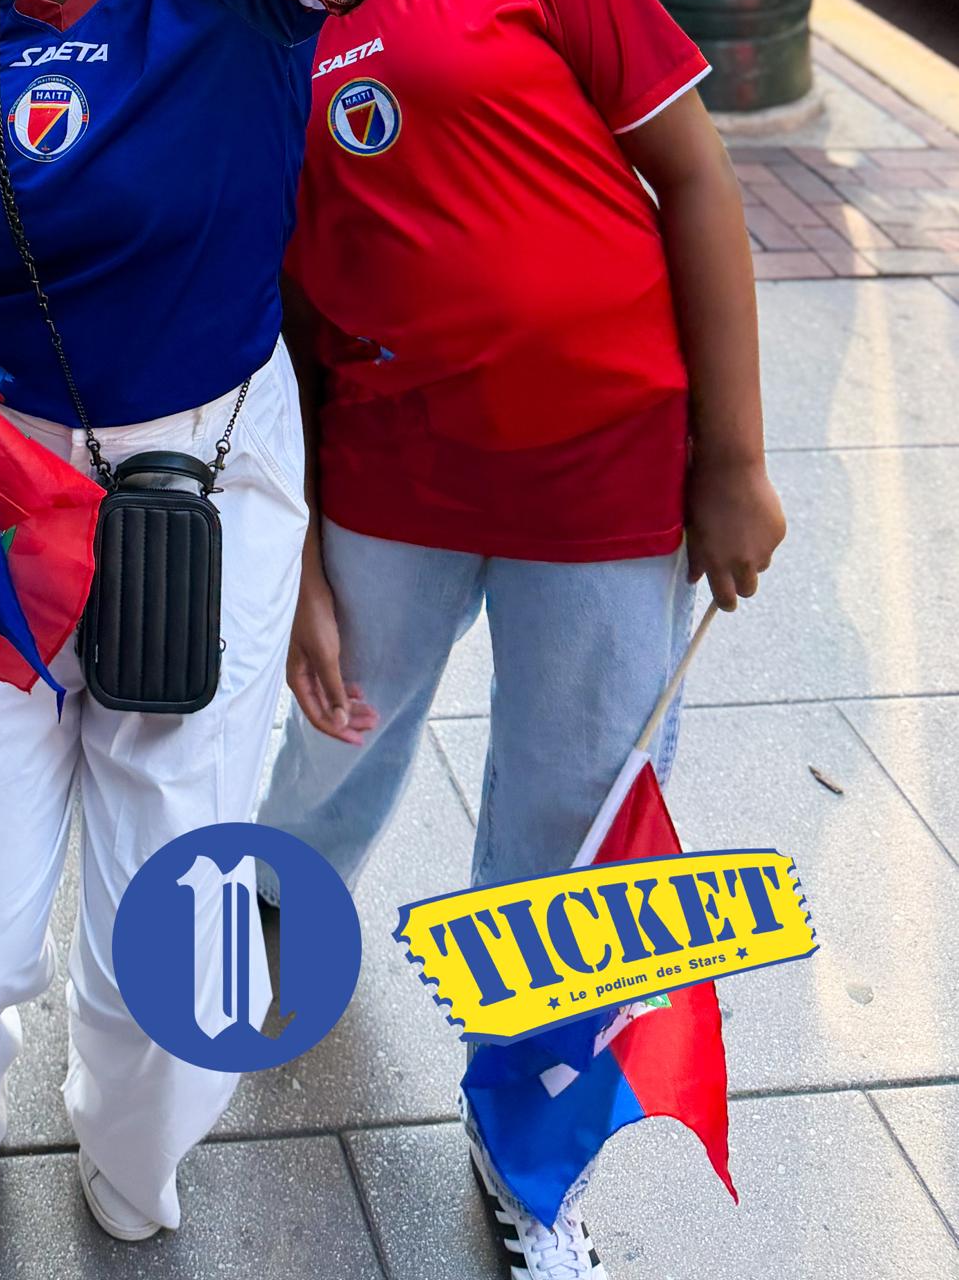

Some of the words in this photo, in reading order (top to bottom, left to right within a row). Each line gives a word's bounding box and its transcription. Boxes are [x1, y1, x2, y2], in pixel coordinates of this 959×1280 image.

[9, 41, 108, 67] SAETA
[312, 37, 384, 79] SAETA
[36, 91, 67, 100] HAITI
[345, 91, 370, 105] HAITI
